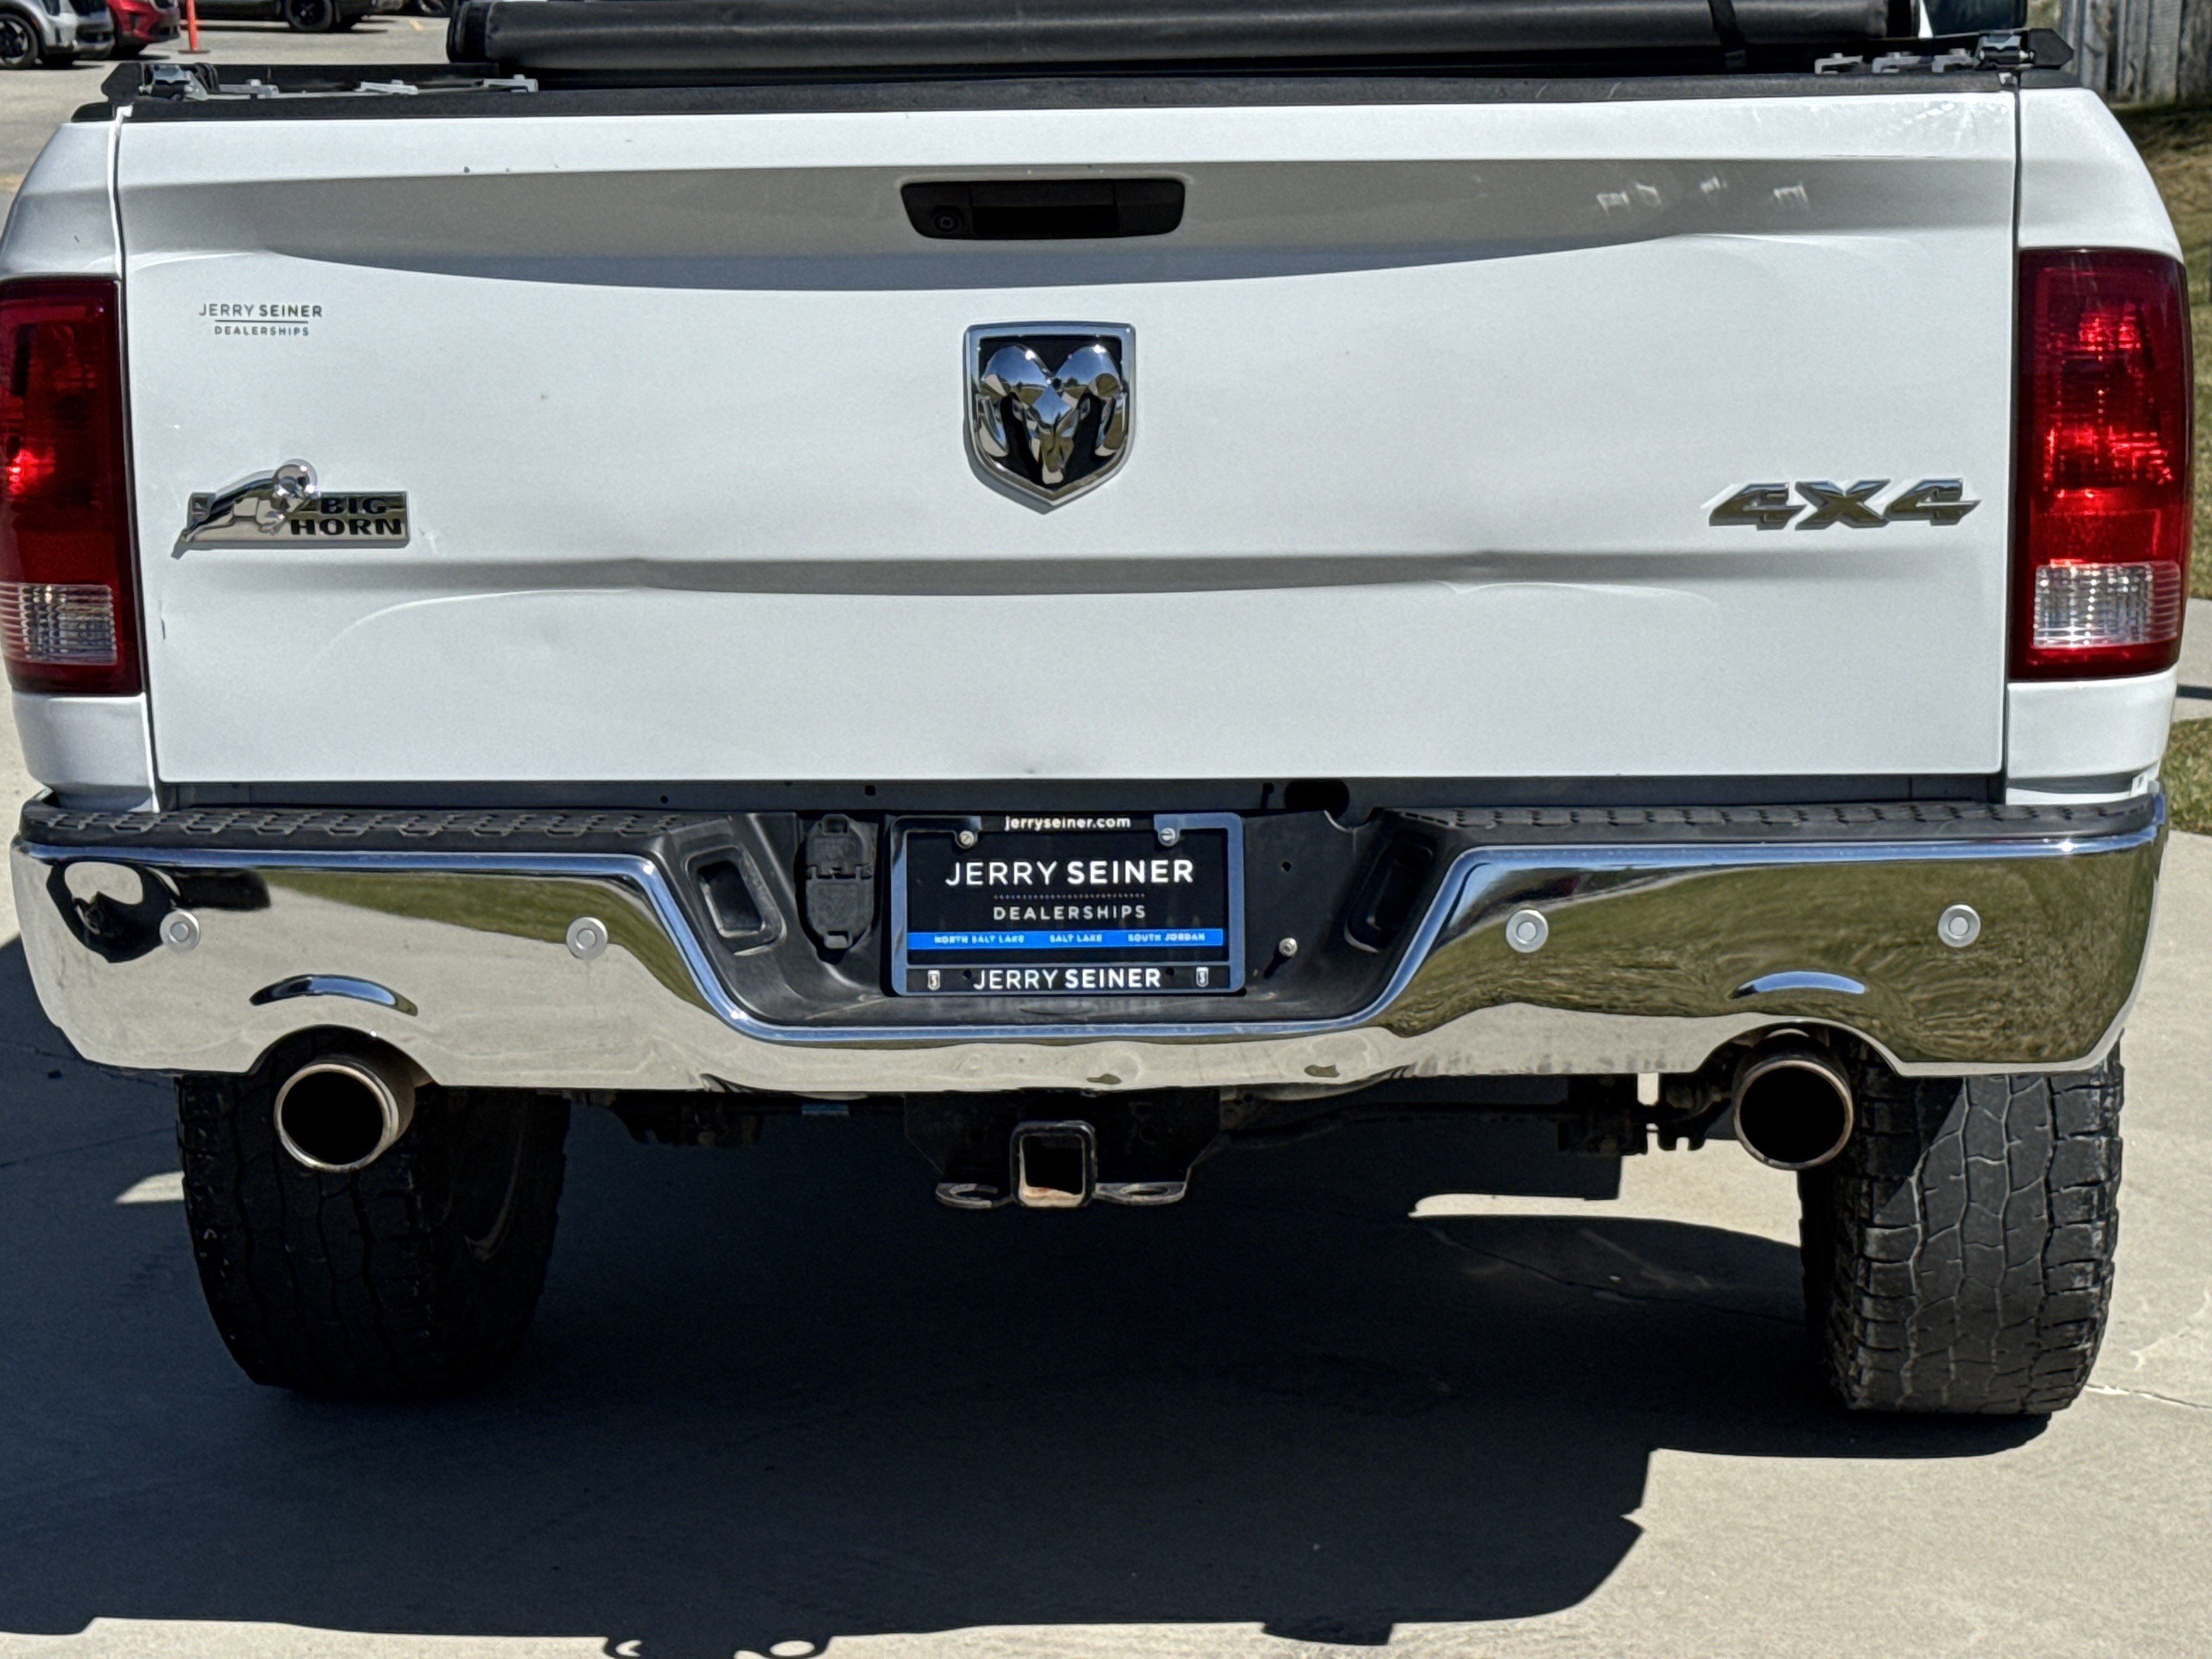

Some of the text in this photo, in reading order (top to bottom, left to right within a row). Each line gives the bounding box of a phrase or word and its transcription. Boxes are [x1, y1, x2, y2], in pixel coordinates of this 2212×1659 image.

[199, 303, 323, 318] JERRY SEINER
[215, 325, 309, 336] DEALERSHIPS
[320, 497, 387, 515] BIG
[291, 518, 402, 535] HORN
[1004, 815, 1131, 831] jerryseiner.com
[945, 859, 1194, 885] JERRY SEINER
[993, 905, 1146, 921] DEALERSHIPS
[1049, 933, 1102, 943] SALT LAKE
[973, 968, 1161, 990] JERRY SEINER
